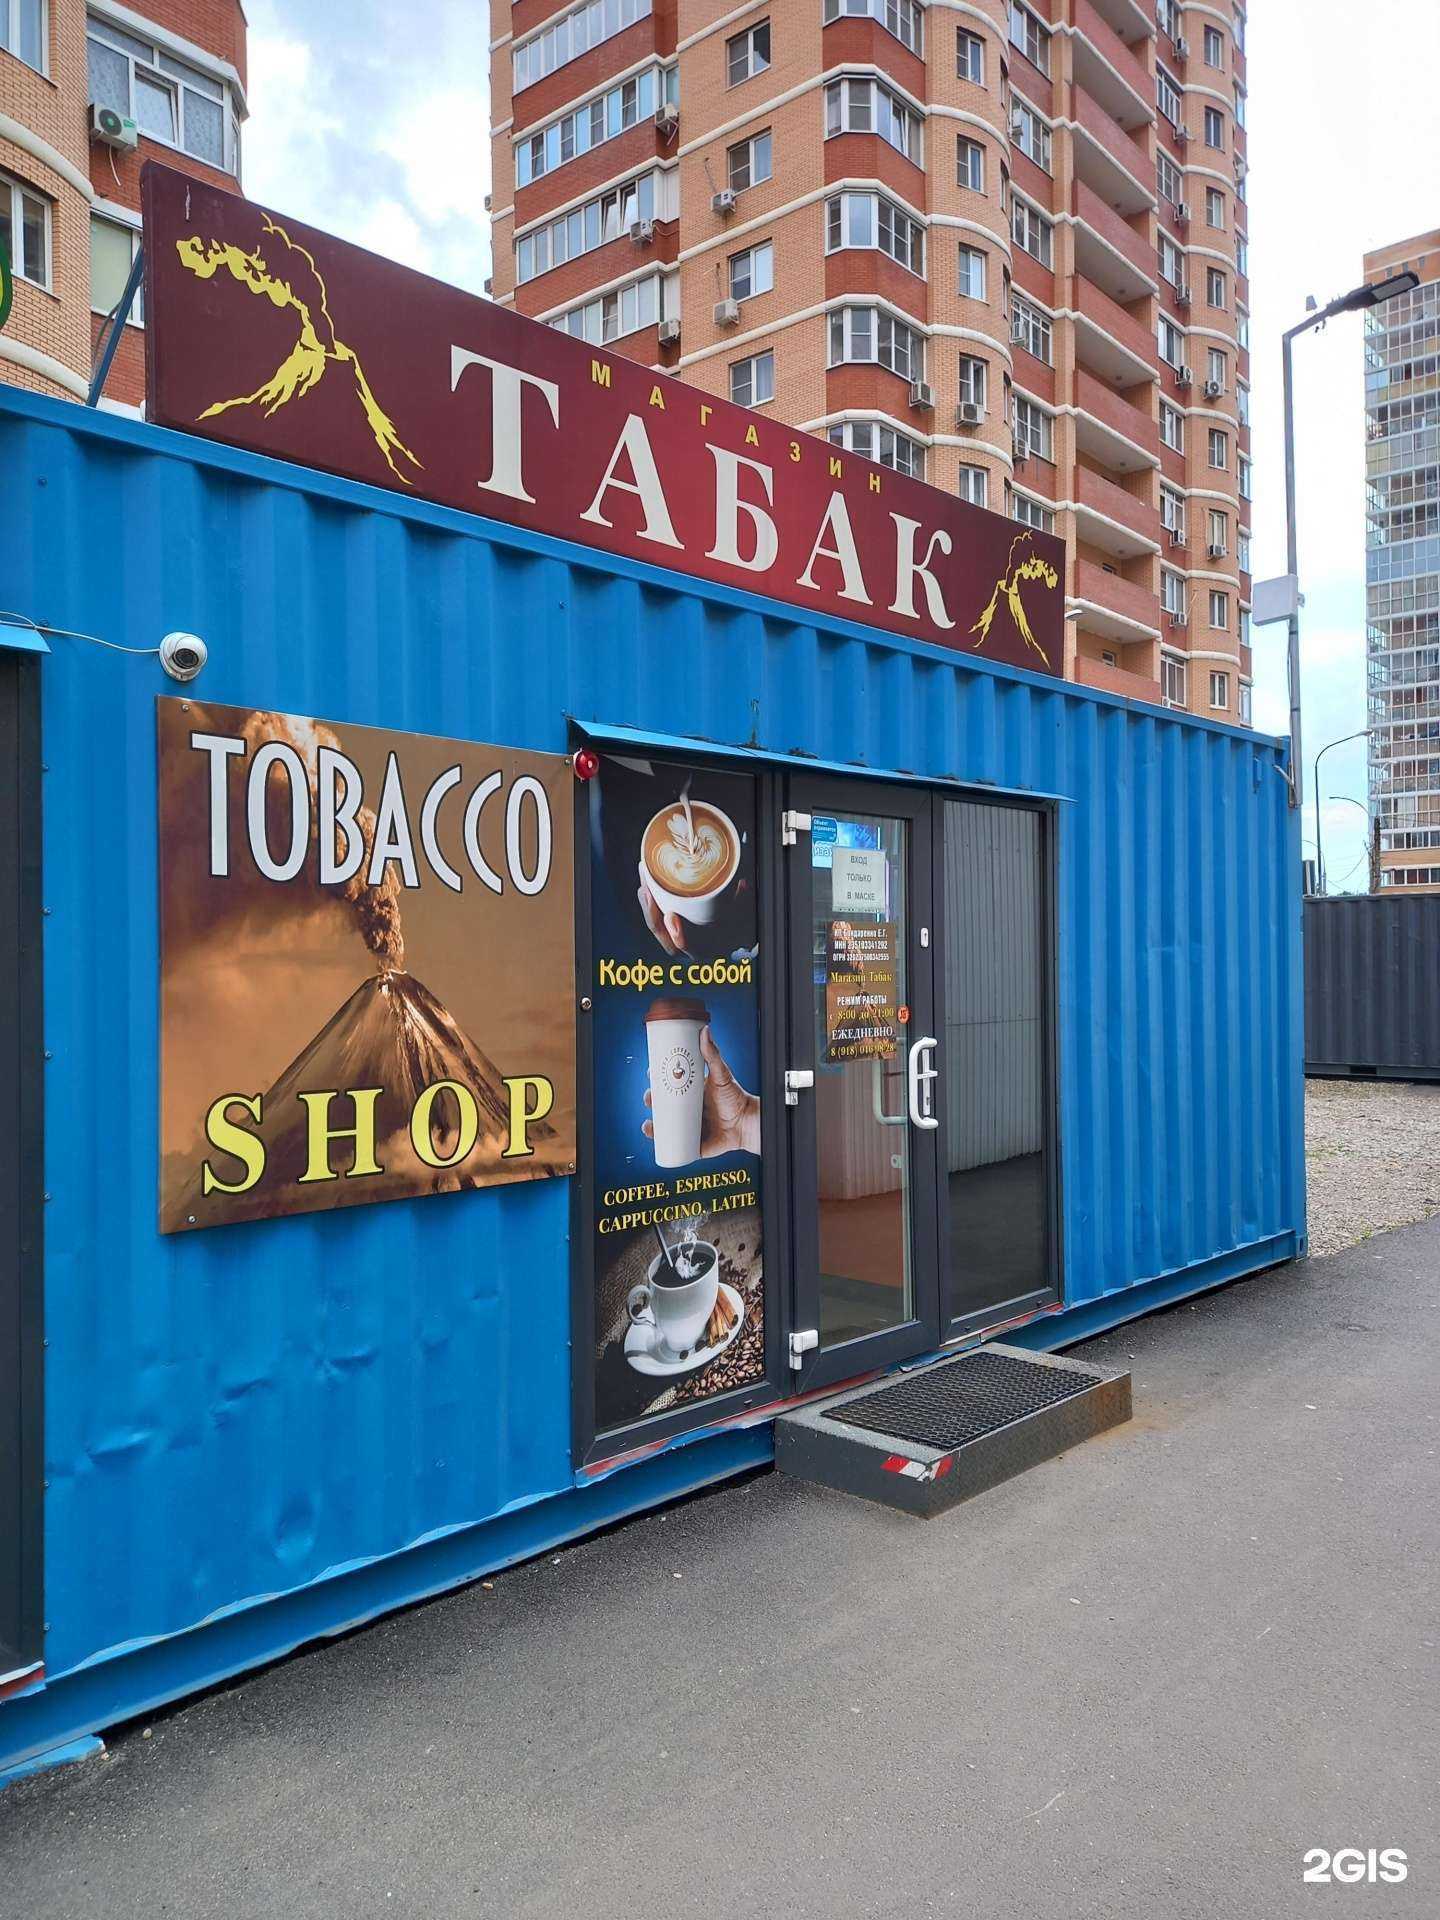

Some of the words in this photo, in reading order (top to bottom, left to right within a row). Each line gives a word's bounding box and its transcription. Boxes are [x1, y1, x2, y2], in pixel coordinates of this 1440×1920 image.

[591, 360, 881, 493] МАГАЗИН
[451, 344, 956, 630] ТАБАК
[191, 732, 553, 897] TOBACCO
[850, 856, 868, 865] ВХОД
[846, 872, 872, 883] ТОЛЬКО
[847, 891, 852, 900] В
[854, 892, 876, 902] МАСКЕ
[834, 941, 847, 949] ИНН
[832, 953, 846, 961] ОГРН
[600, 958, 664, 991] Кофе
[669, 965, 683, 983] с
[687, 958, 751, 984] собой
[830, 971, 866, 984] Магазин
[869, 971, 893, 982] Табак
[837, 995, 861, 1006] РЕЖИМ
[862, 994, 887, 1005] РАБОТЫ
[838, 1008, 856, 1020] 8:00
[872, 1007, 895, 1018] 21:00
[831, 1026, 893, 1041] ЕЖЕДНЕВНО
[202, 1074, 554, 1197] SHOP
[604, 1182, 670, 1207] COFFEE,
[676, 1169, 751, 1194] ESPRESSO,
[712, 1191, 756, 1213] LATTE
